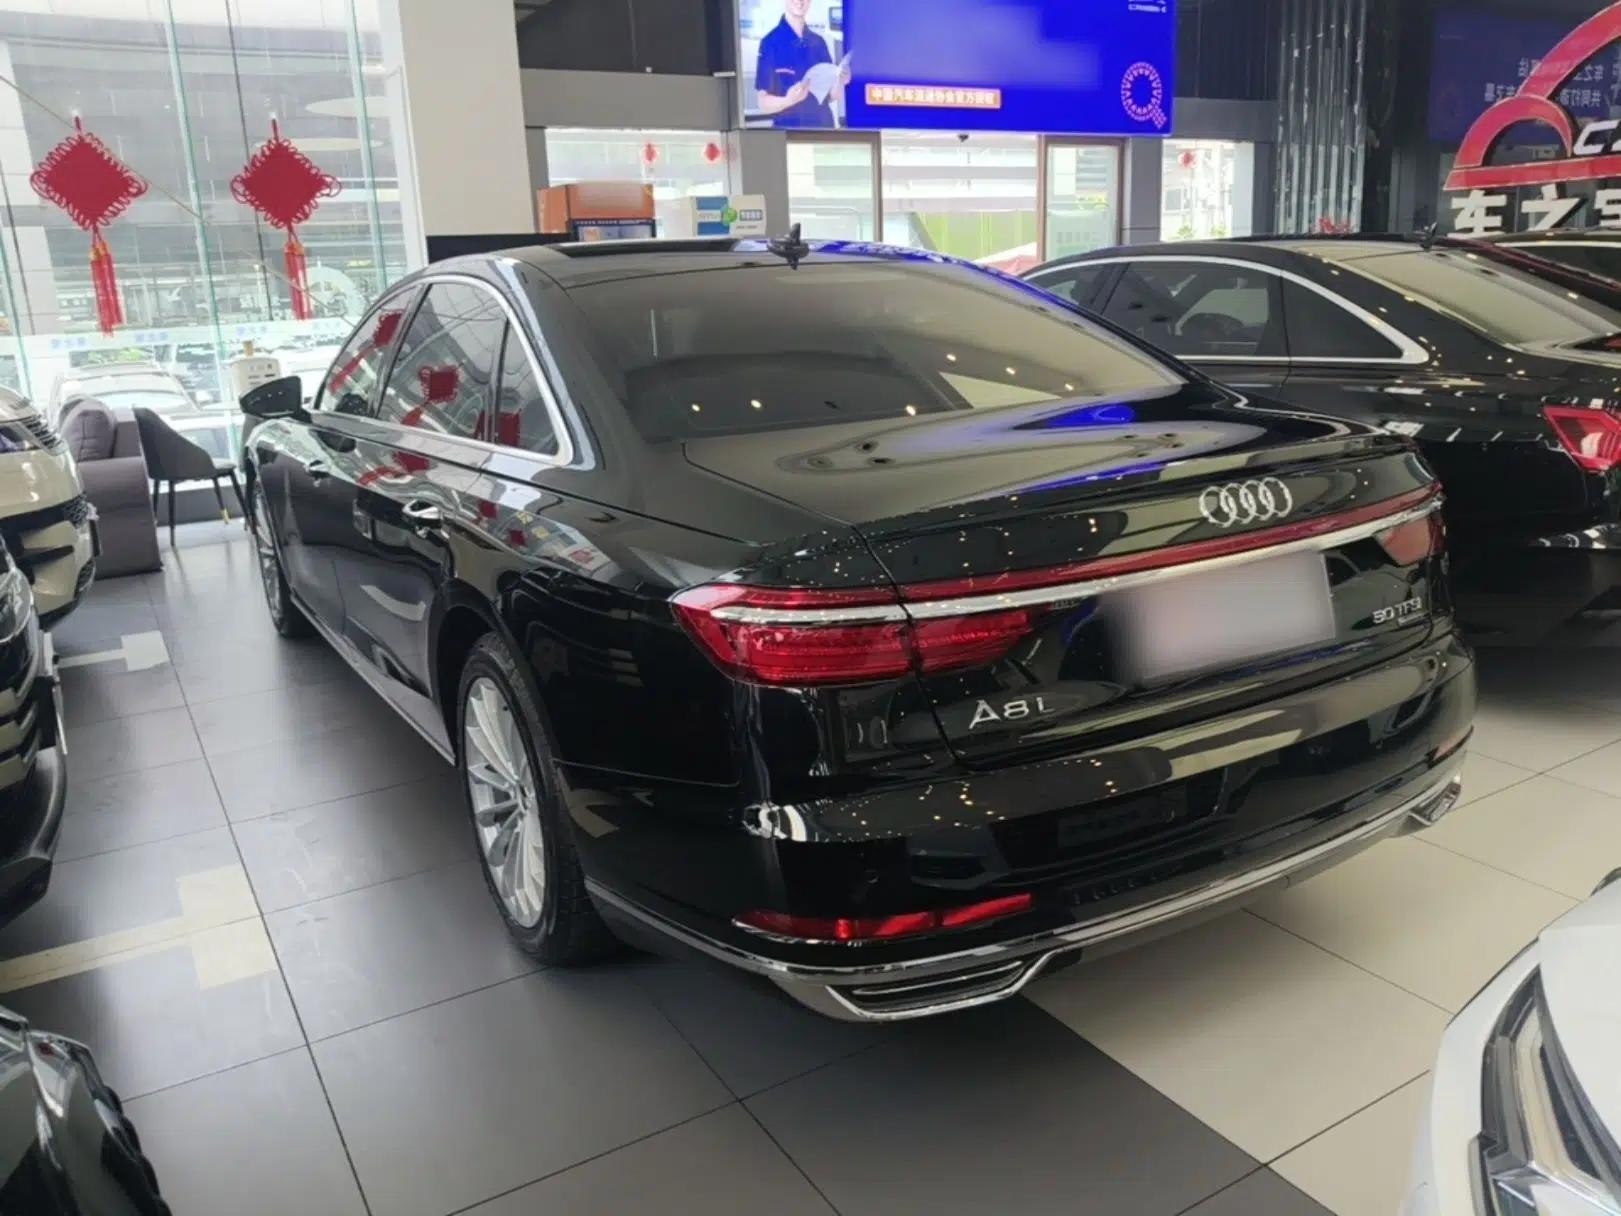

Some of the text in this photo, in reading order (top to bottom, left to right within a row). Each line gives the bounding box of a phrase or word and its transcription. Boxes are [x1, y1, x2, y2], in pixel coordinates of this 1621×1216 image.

[1573, 119, 1621, 155] C
[1372, 606, 1395, 624] 50
[1395, 596, 1422, 615] TFSI
[968, 696, 1056, 730] A8L
